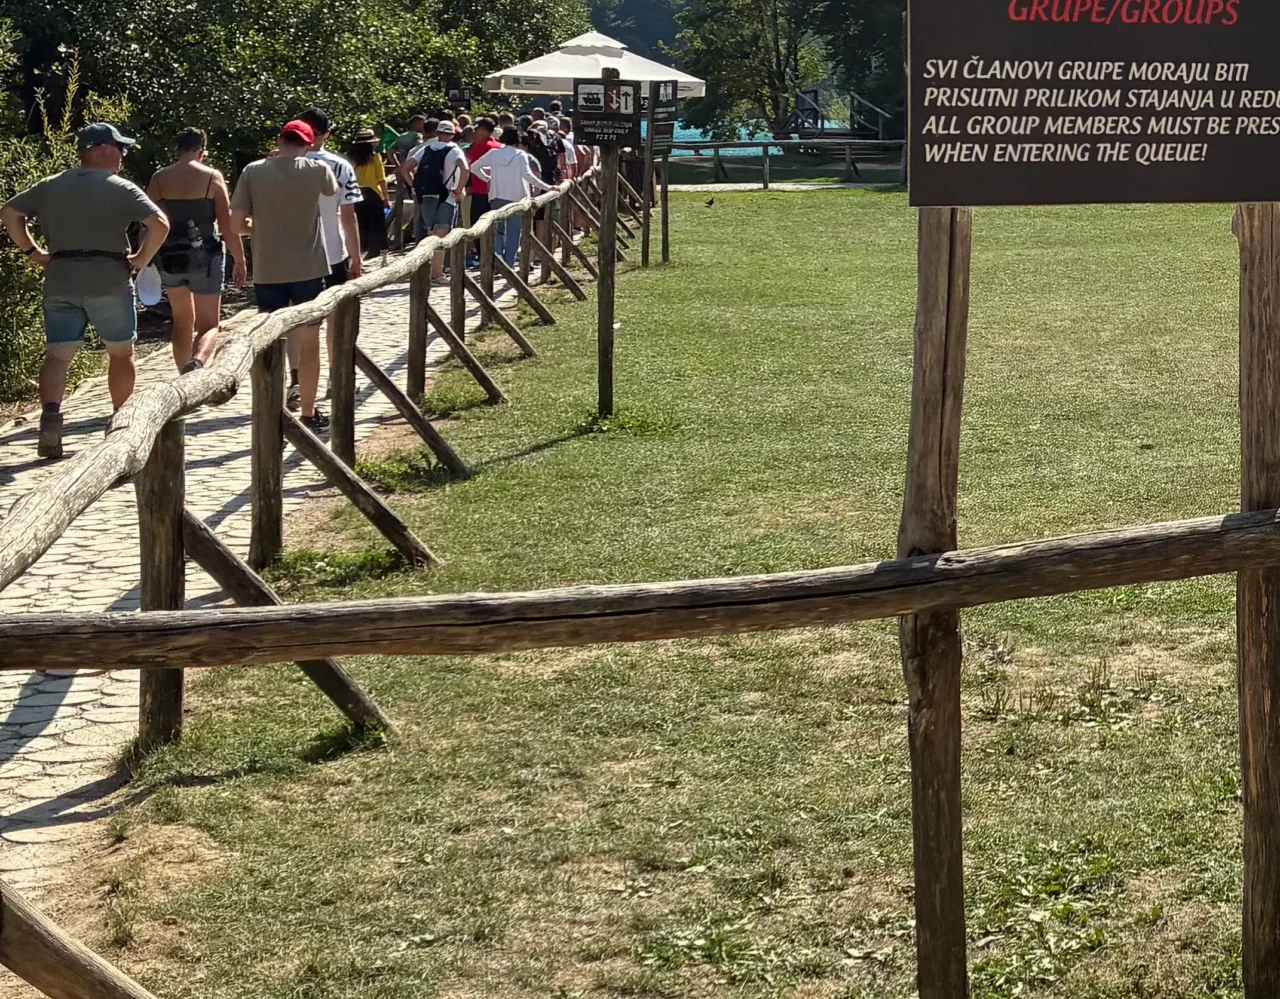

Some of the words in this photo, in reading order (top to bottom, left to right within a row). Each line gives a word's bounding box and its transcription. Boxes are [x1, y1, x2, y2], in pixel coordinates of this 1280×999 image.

[923, 59, 958, 79] SVI
[962, 55, 1054, 80] ČLANOVI
[1058, 60, 1125, 81] GRUPE
[1128, 61, 1211, 85] MORAJU
[1214, 62, 1250, 82] BITI
[923, 87, 1019, 107] PRISUTNI
[1023, 88, 1121, 108] PRILIKOM
[1125, 89, 1214, 112] STAJANJA
[1220, 89, 1235, 109] U
[921, 115, 961, 135] ALL
[966, 115, 1040, 135] GROUP
[1043, 115, 1143, 135] MEMBERS
[1147, 116, 1206, 135] MUST
[1206, 116, 1232, 135] BE
[924, 141, 989, 164] WHEN
[993, 143, 1091, 162] ENTERING
[1096, 141, 1132, 163] THE
[1135, 143, 1208, 166] QUEUE!
